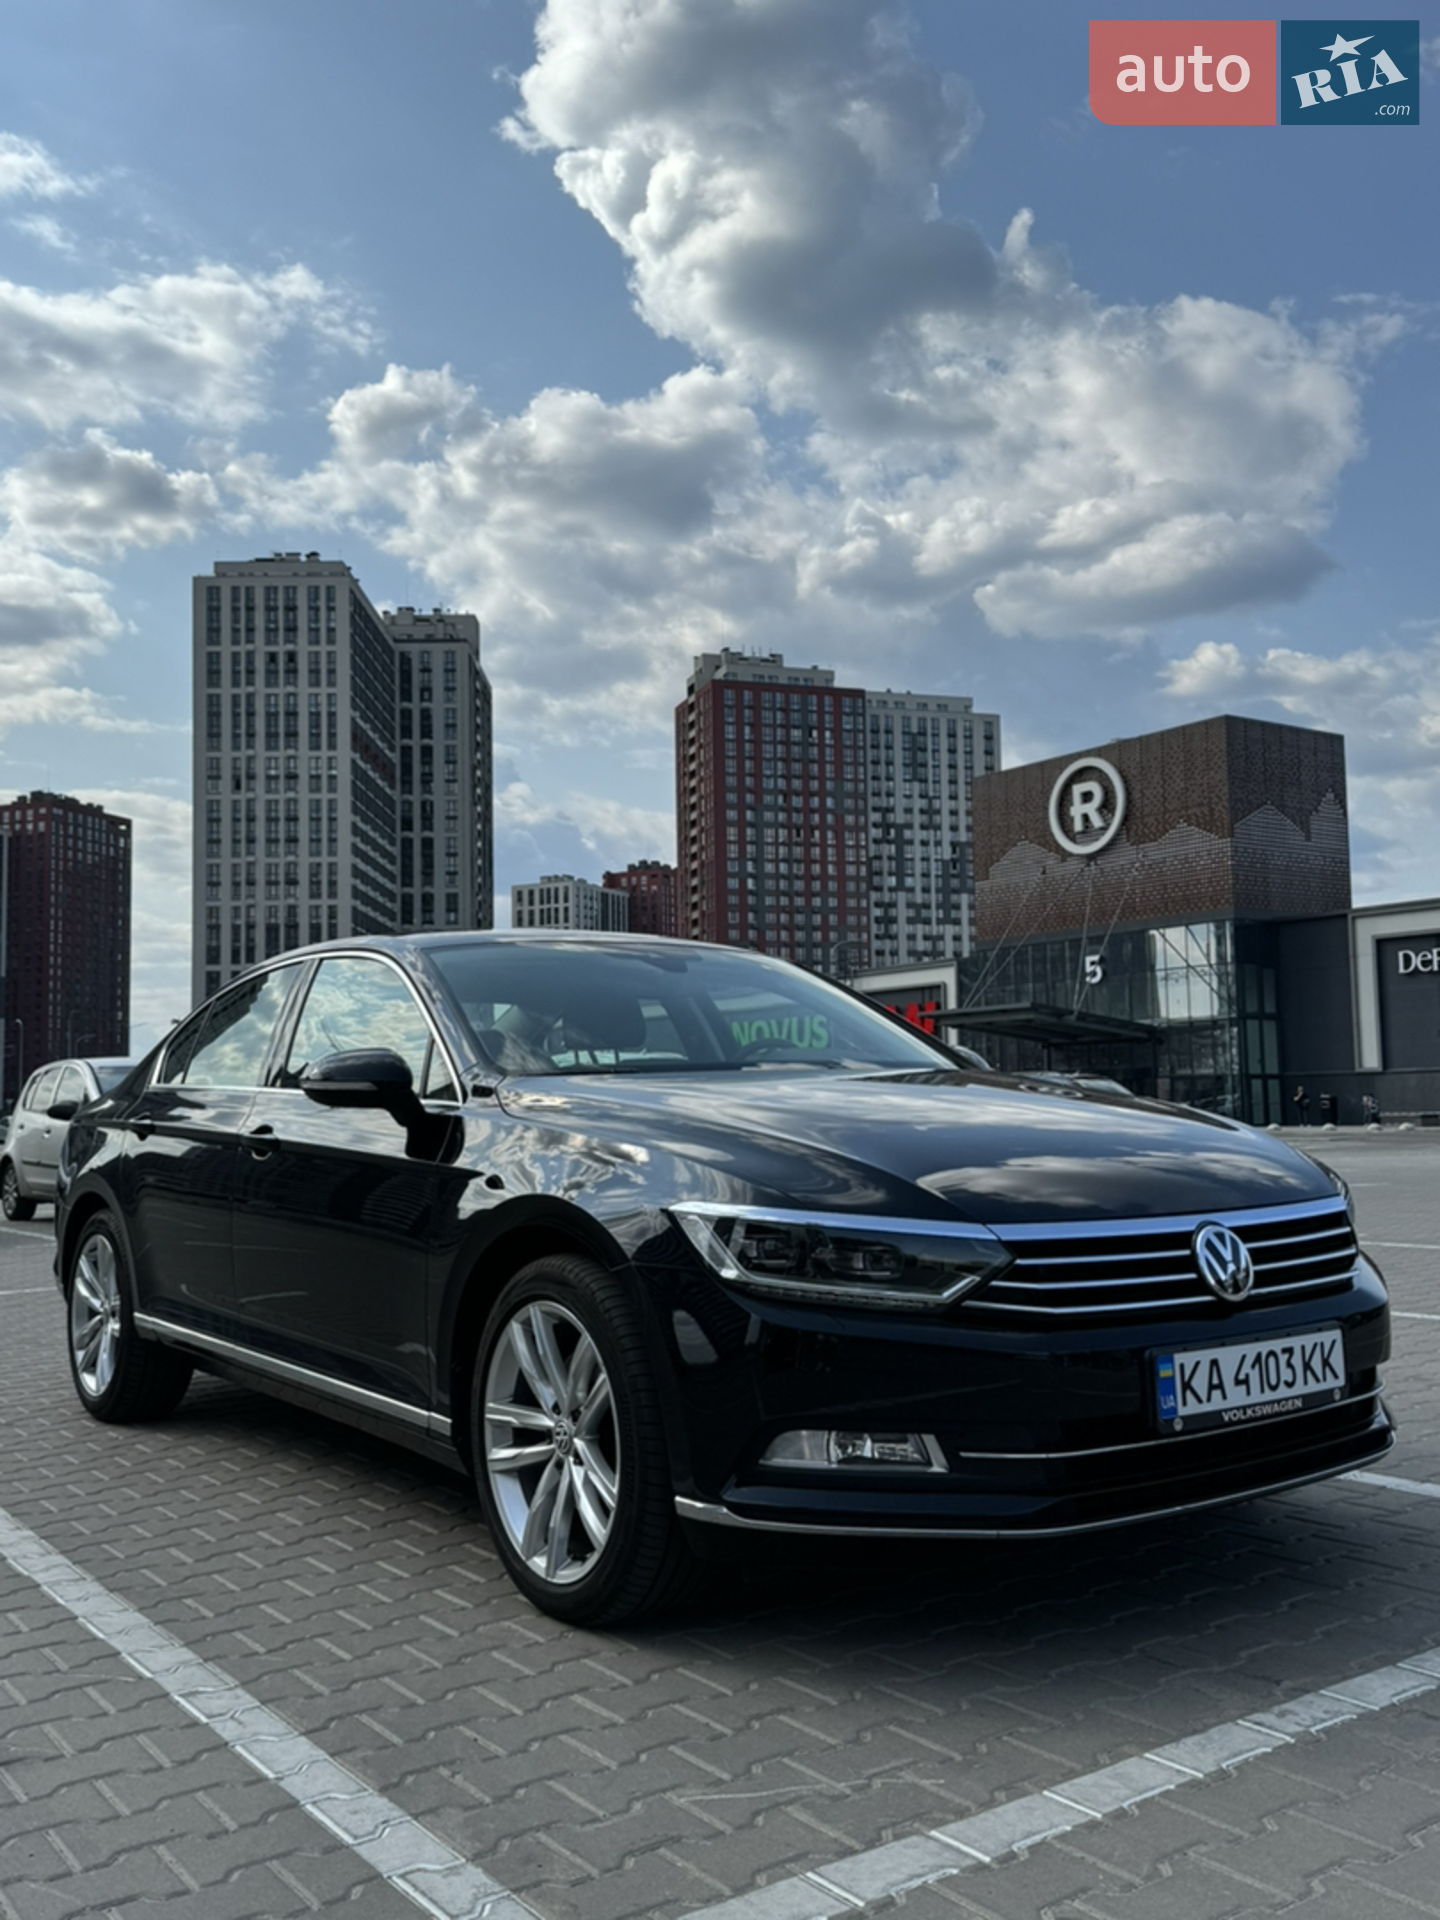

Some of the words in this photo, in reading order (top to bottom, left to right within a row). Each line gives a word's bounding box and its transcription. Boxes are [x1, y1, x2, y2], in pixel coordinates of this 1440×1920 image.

[1084, 953, 1103, 985] 5
[731, 1014, 829, 1049] NOVUS
[1161, 1394, 1176, 1410] UA
[1221, 1397, 1303, 1422] VOLKSWAGEN
